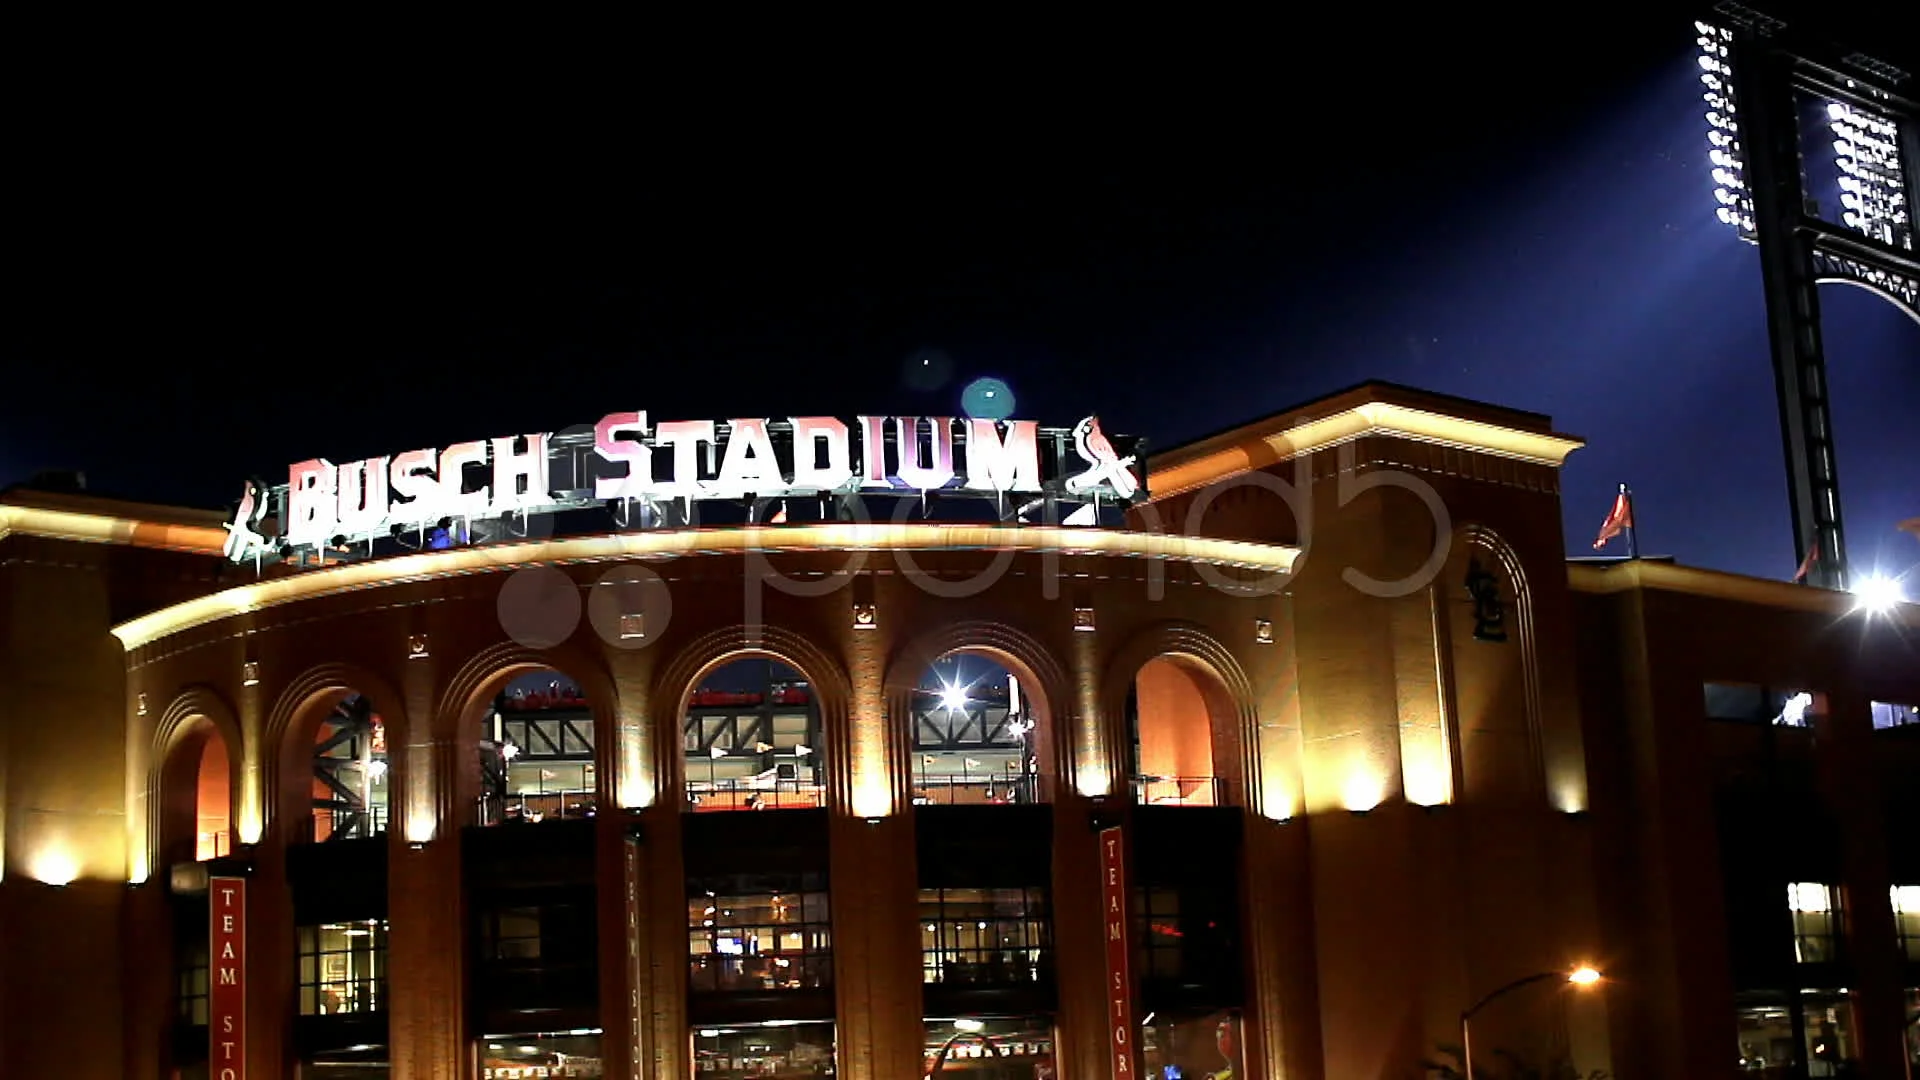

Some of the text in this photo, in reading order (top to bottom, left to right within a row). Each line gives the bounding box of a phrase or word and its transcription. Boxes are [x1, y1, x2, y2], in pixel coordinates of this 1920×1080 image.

[289, 411, 1042, 545] BUSCH STADIUM
[219, 888, 237, 985] TEAM
[1106, 839, 1122, 941] TEAM
